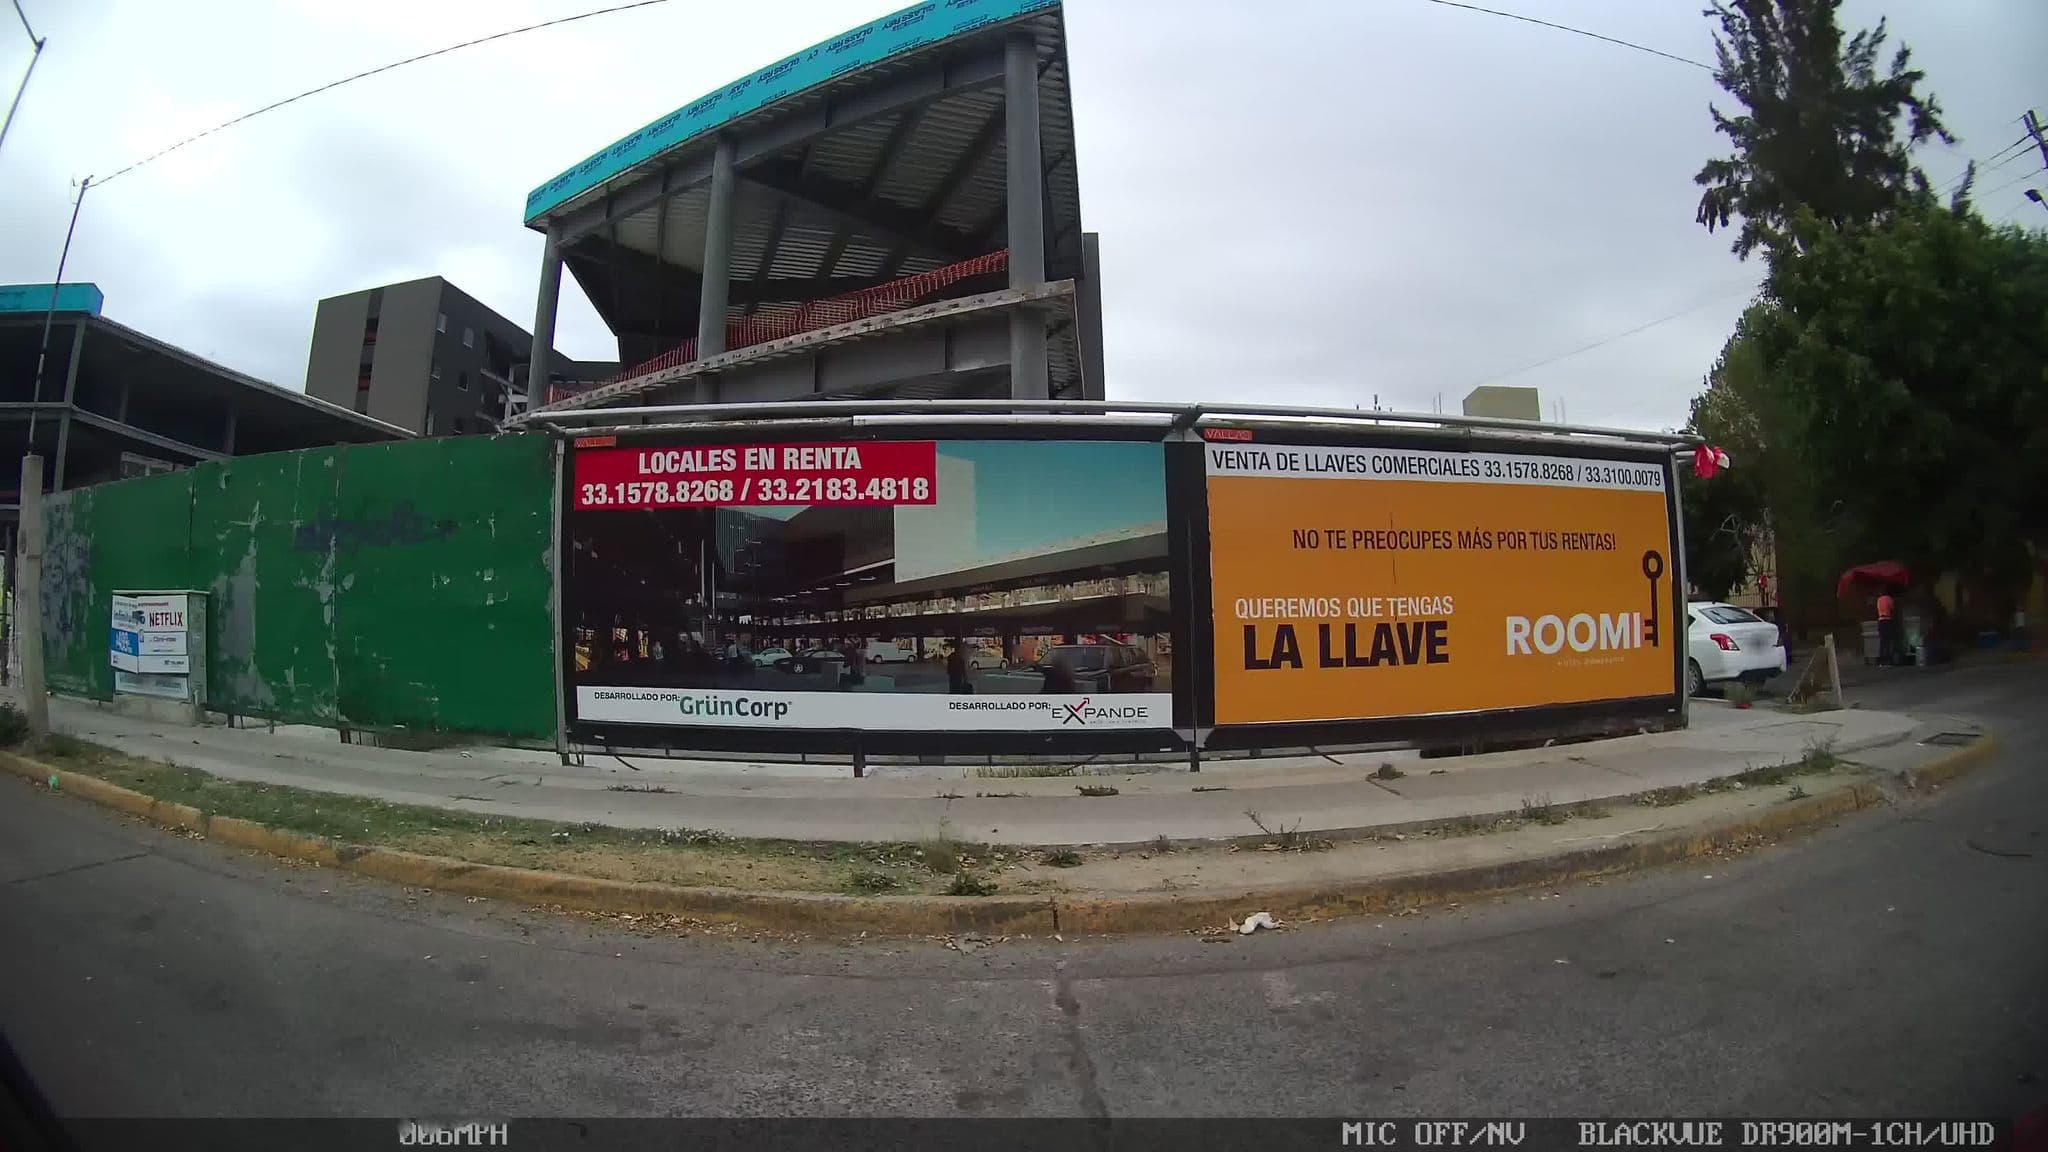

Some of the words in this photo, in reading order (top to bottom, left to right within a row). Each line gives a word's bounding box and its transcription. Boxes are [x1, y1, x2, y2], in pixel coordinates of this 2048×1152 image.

[639, 449, 736, 474] LOCALES
[744, 448, 775, 470] EN
[784, 447, 861, 470] RENTA
[1212, 450, 1271, 470] VENTA
[1277, 453, 1300, 471] DE
[1305, 453, 1366, 473] LLAVES
[1372, 455, 1479, 477] COMERCIALES
[1484, 460, 1574, 481] 33.1578.8268
[1576, 465, 1582, 482] /
[1585, 466, 1661, 486] 33.3100.0079
[582, 480, 734, 505] 33.1578.8268
[740, 478, 751, 501] /
[758, 477, 929, 500] 33.2183.4818
[1293, 529, 1319, 549] NO
[1324, 530, 1346, 549] TE
[1352, 530, 1452, 550] PREOCUPES
[1458, 527, 1492, 549] MÁS
[1498, 531, 1527, 549] POR
[1529, 532, 1558, 550] TUS
[1562, 532, 1617, 550] RENTAS!
[1235, 598, 1340, 618] QUEREMOS
[1347, 598, 1383, 617] QUE
[1386, 596, 1454, 617] TENGAS
[149, 612, 183, 627] NETFLIX
[1244, 624, 1303, 670] LA
[1318, 620, 1449, 668] LLAVE
[594, 691, 658, 701] DESARROLLADO
[660, 693, 680, 702] POR:
[680, 696, 789, 720] GrünCorp
[949, 702, 1026, 710] DESARROLLADO
[1029, 702, 1050, 710] POR:
[1052, 698, 1149, 724] EXPANDE
